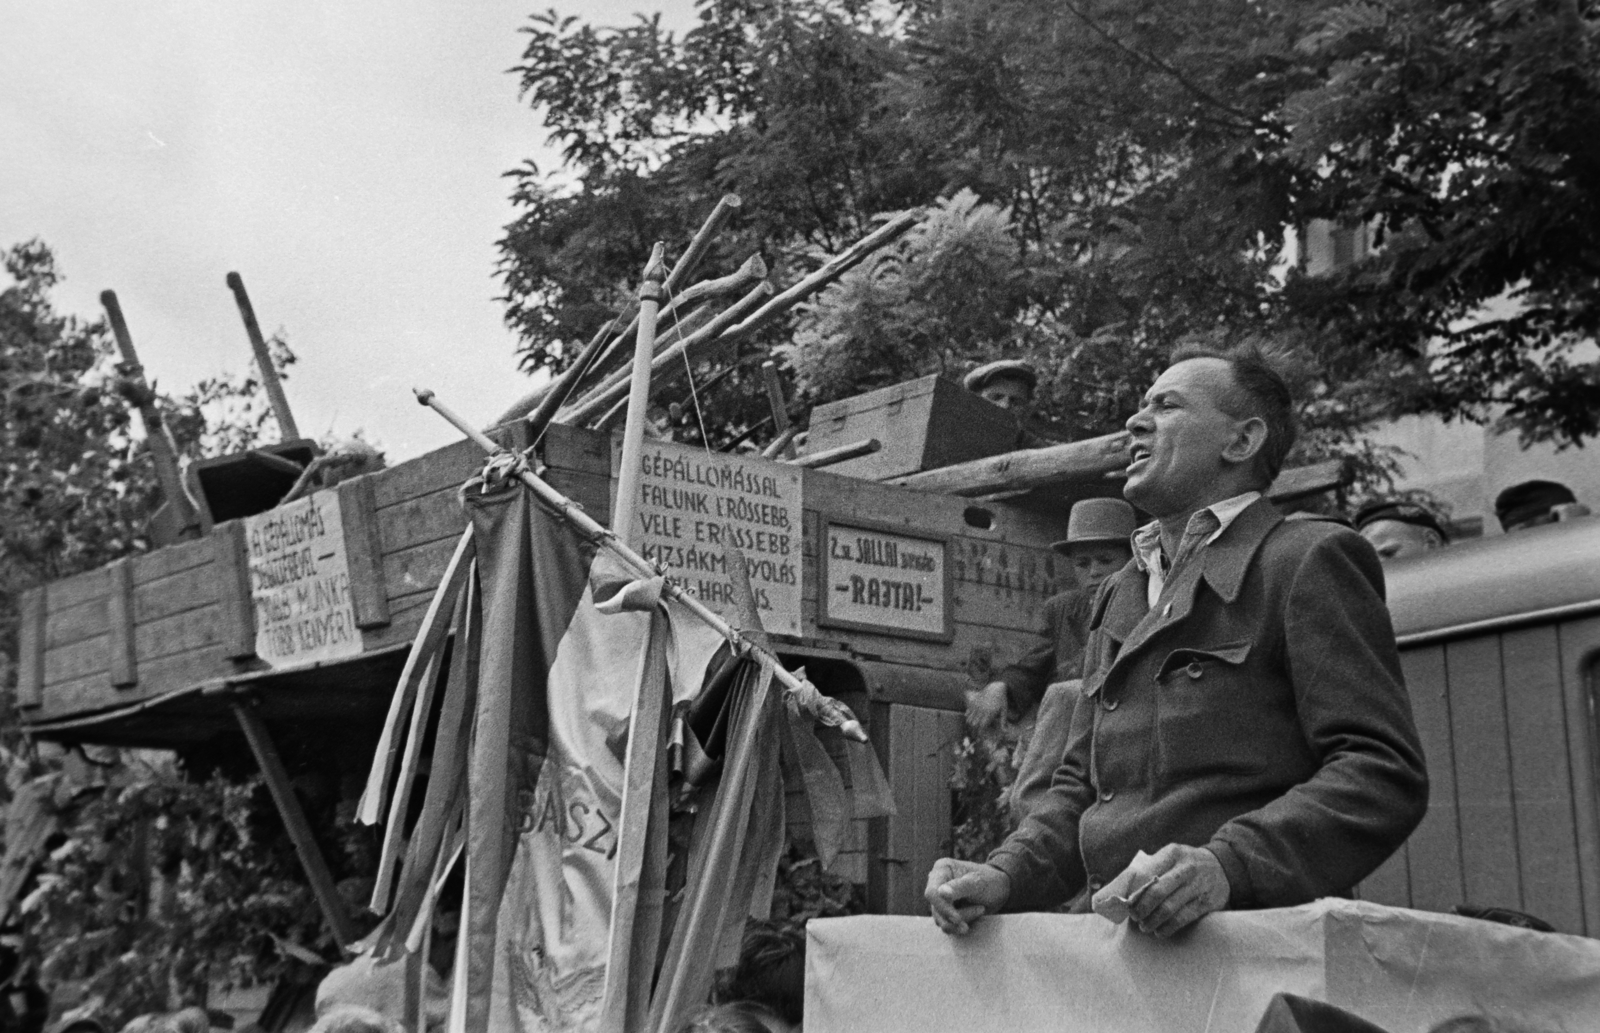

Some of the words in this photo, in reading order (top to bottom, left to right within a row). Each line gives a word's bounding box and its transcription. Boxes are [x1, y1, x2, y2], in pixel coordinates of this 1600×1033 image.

[641, 450, 781, 498] GÉPÁLLOMÁSSAL
[641, 483, 709, 514] FALUNK
[640, 512, 681, 539] VELE
[855, 537, 897, 567] SALLAI
[297, 573, 349, 612] MUNKA
